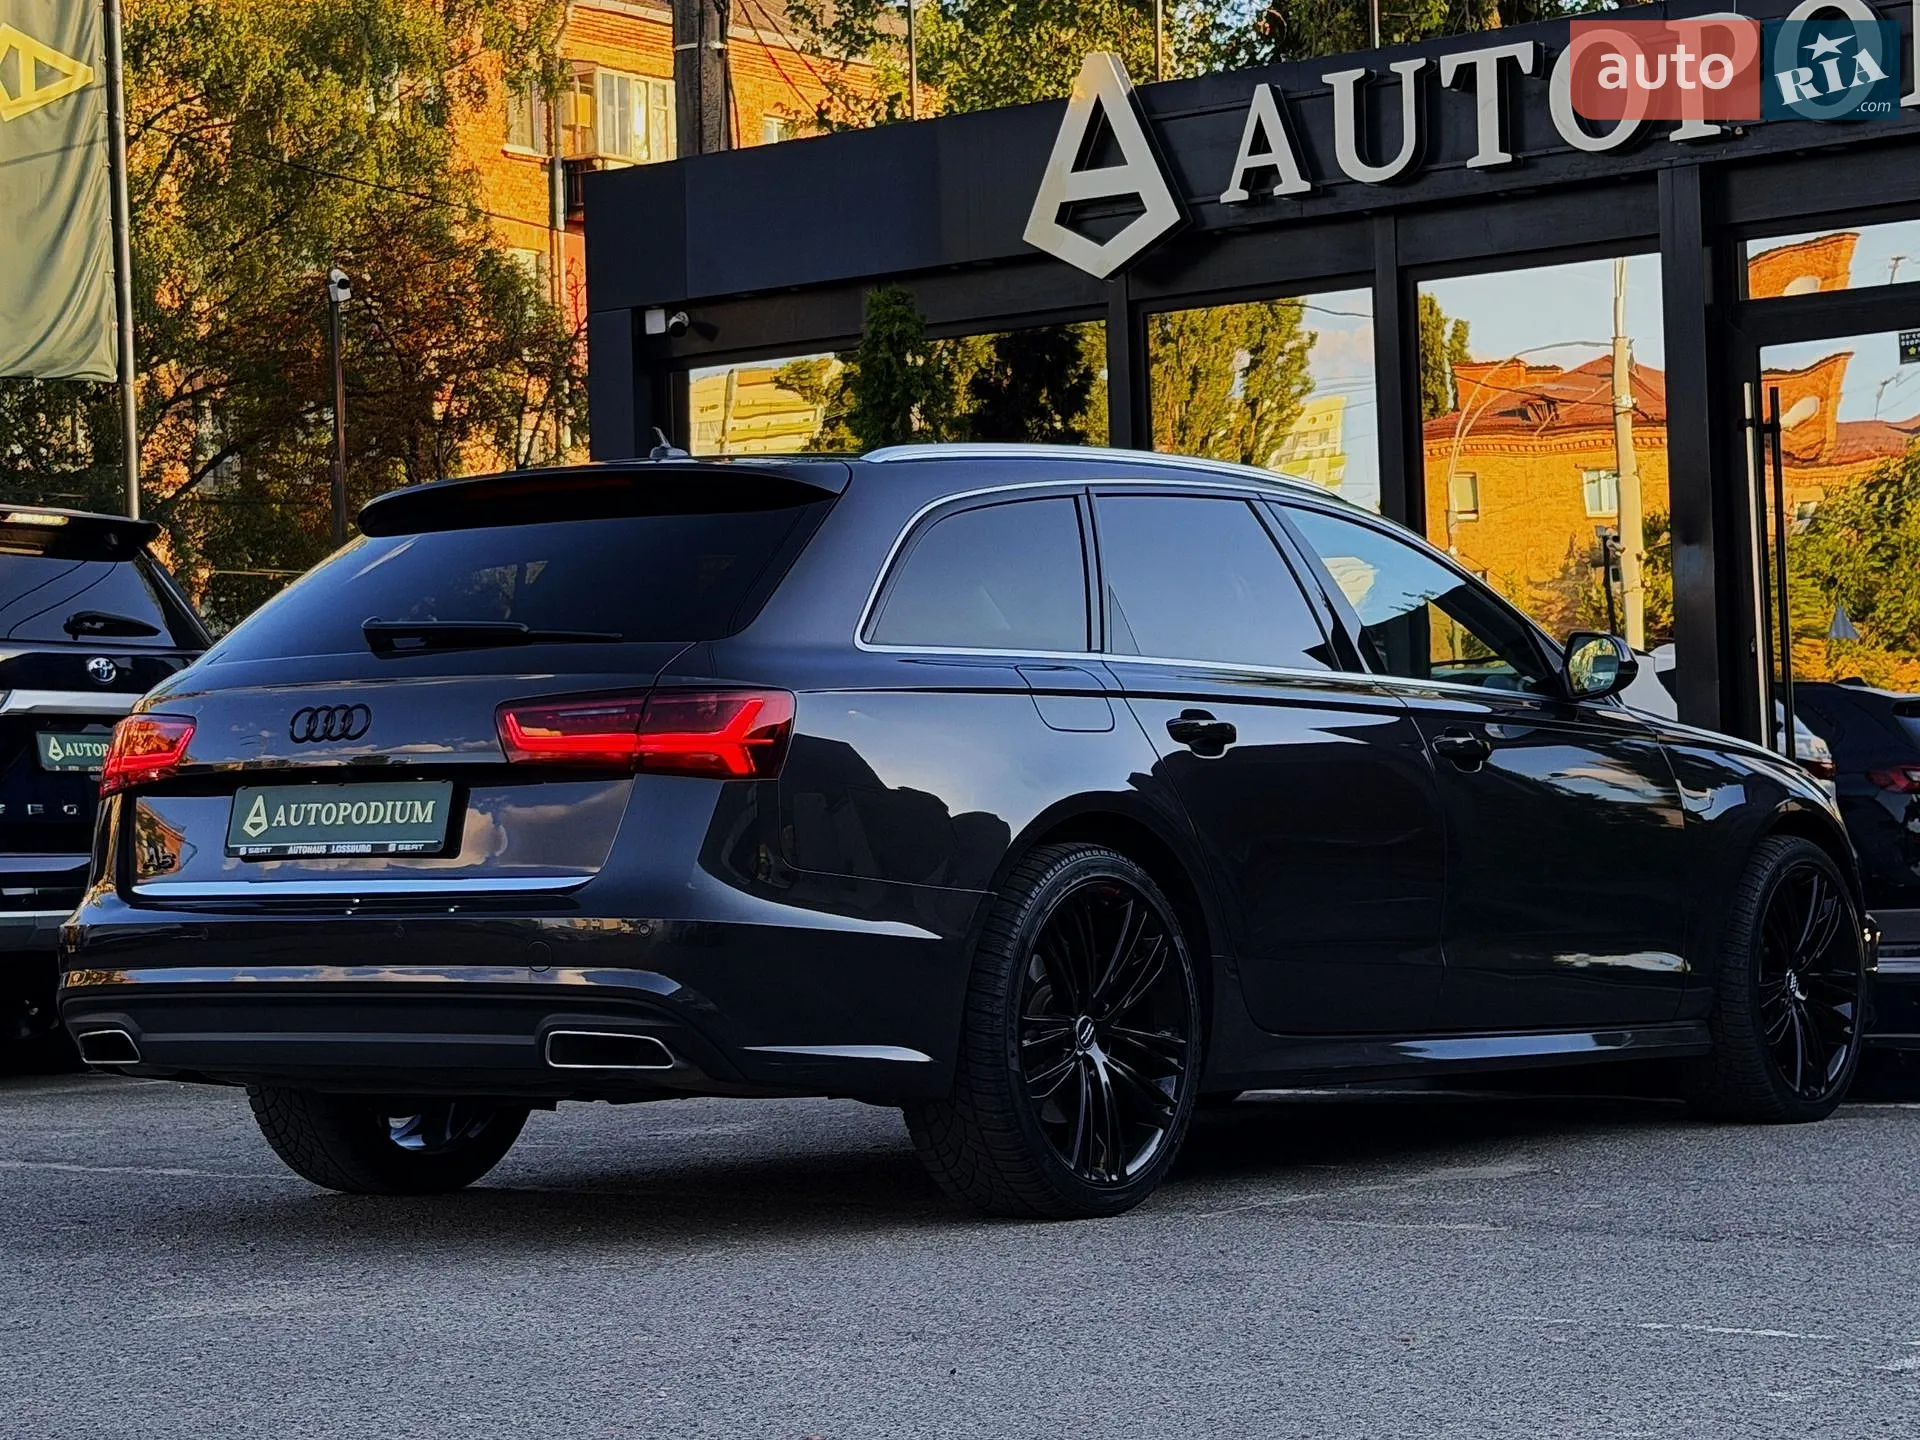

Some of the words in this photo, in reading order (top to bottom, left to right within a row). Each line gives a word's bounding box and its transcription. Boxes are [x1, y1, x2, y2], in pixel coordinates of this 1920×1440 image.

[65, 742, 110, 757] AUTOP
[271, 800, 436, 827] AUTOPODIUM
[287, 844, 327, 855] AUTOHAUS
